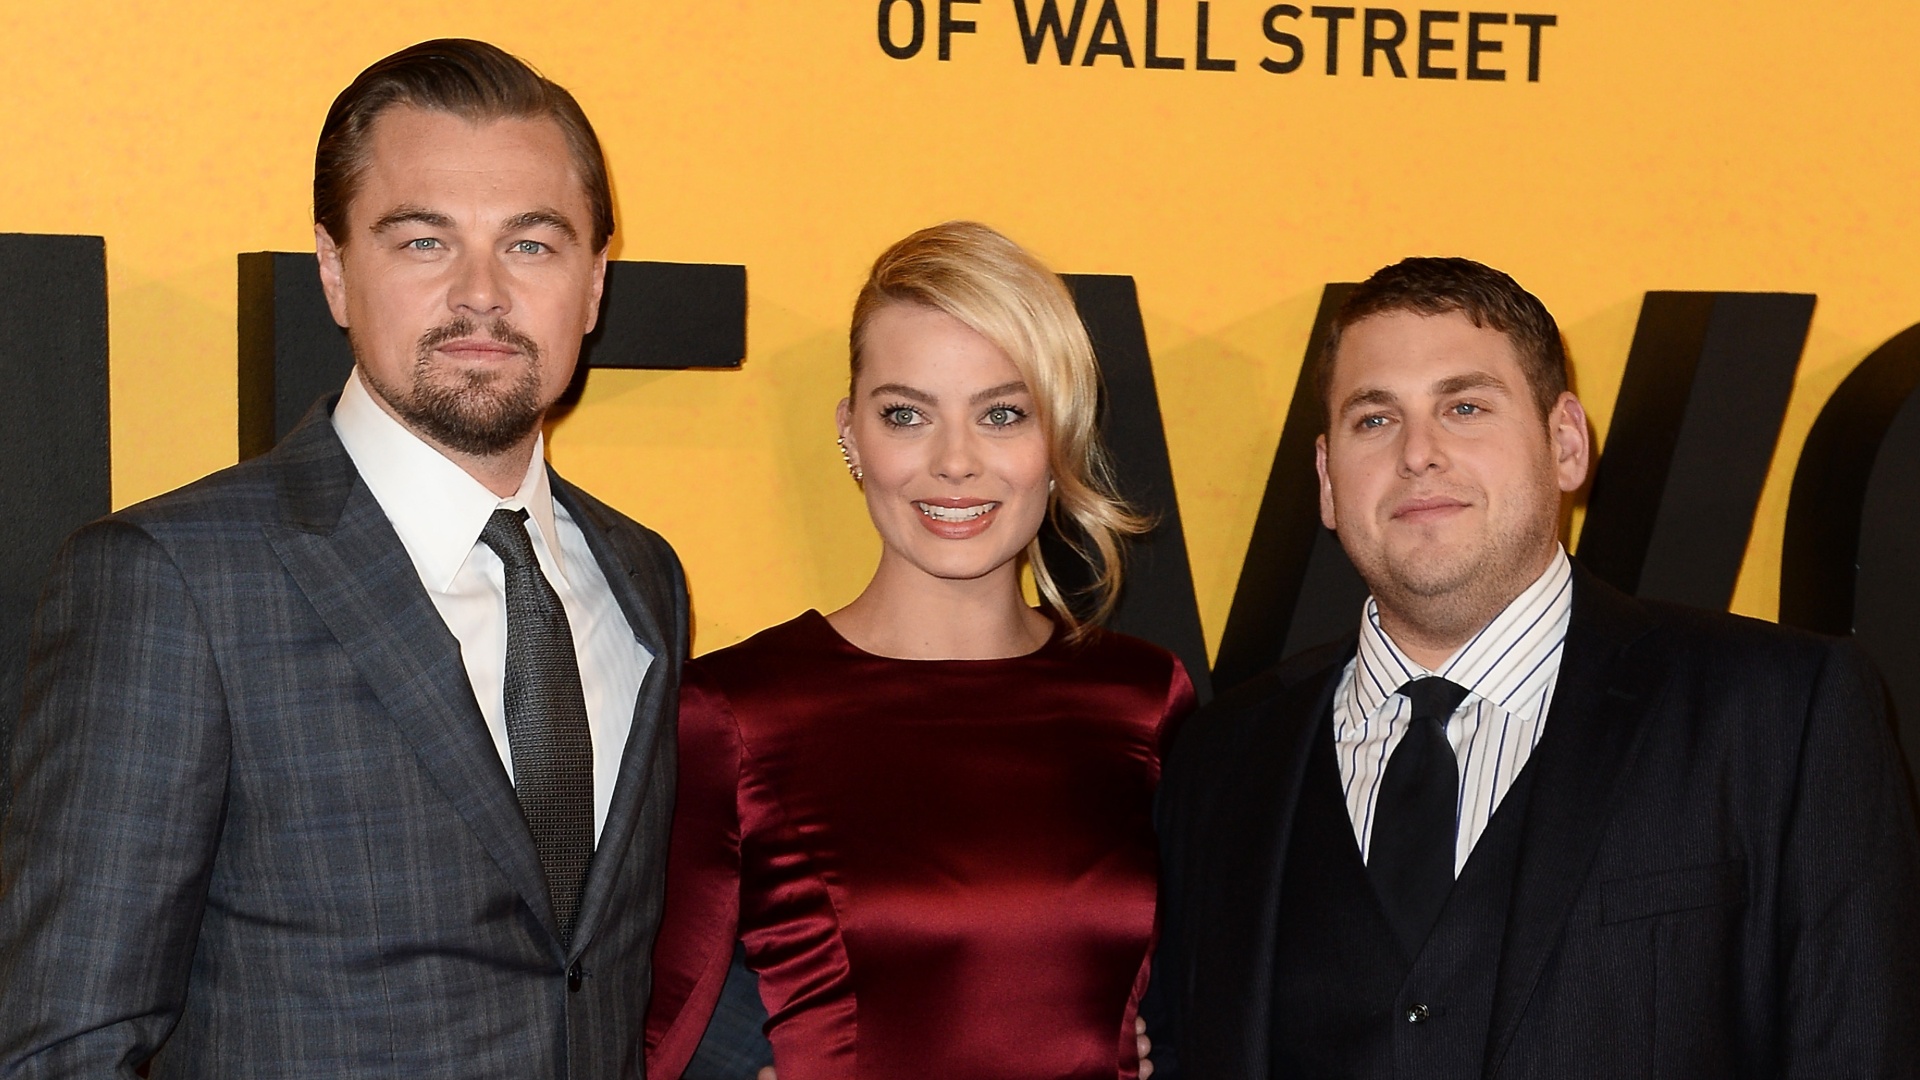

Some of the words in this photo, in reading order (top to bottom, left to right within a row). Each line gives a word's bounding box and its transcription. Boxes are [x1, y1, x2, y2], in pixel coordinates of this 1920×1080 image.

[877, 0, 981, 62] OF
[1013, 0, 1236, 72] WALL
[1259, 3, 1557, 83] STREET
